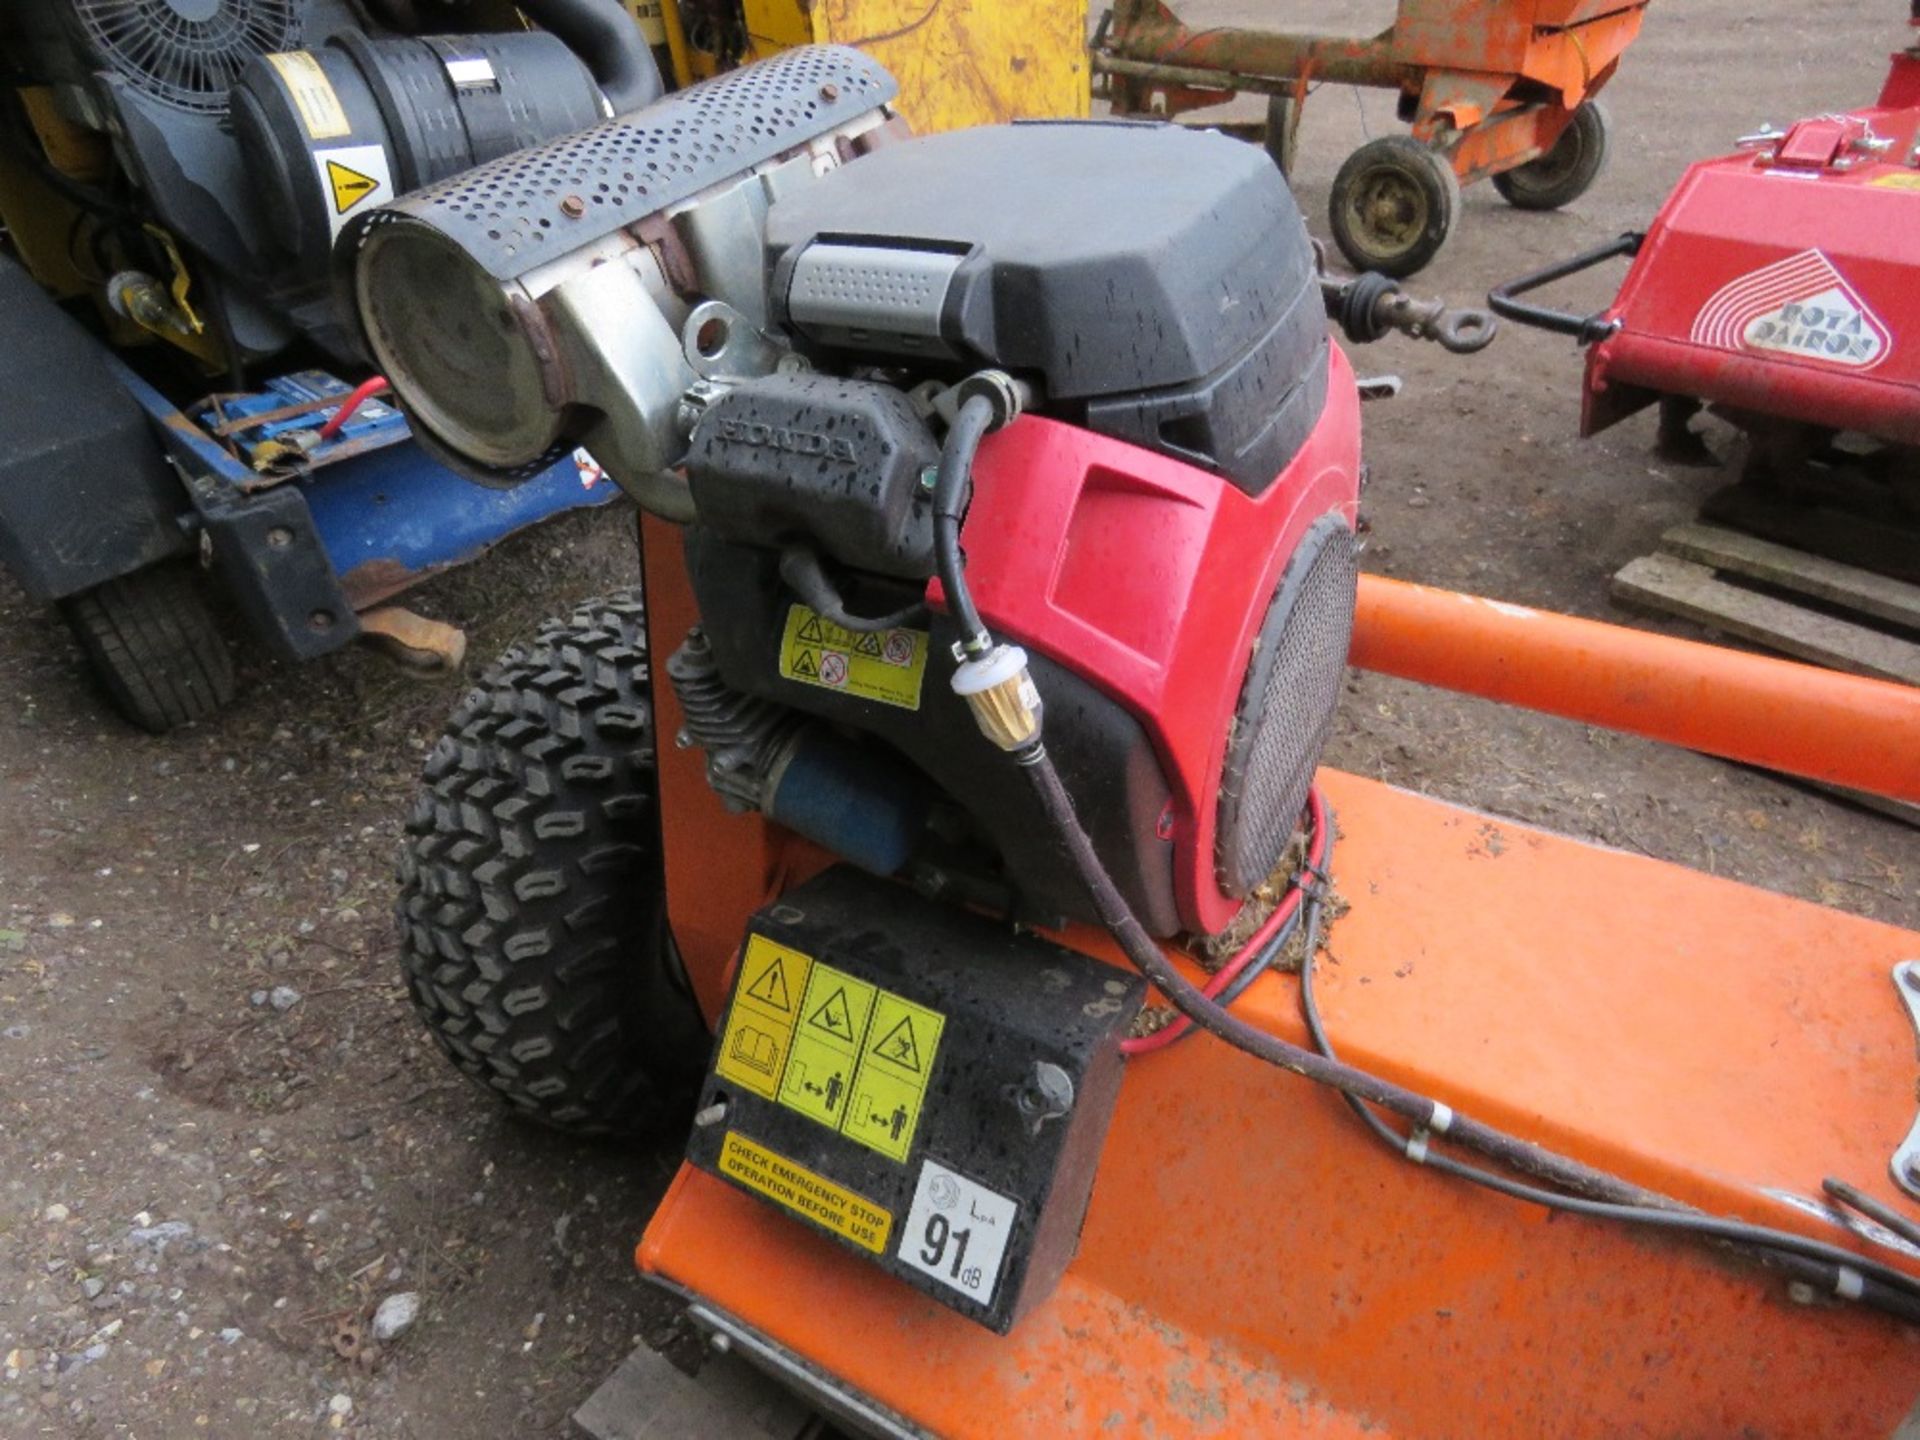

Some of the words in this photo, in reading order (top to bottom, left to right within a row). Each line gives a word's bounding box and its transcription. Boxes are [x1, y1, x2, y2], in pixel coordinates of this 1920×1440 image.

[1754, 322, 1873, 361] DAIRON
[1780, 301, 1862, 334] ROTA
[715, 418, 857, 464] HONDA
[728, 1158, 795, 1200] OPERATION
[797, 1194, 845, 1227] BEFORE
[850, 1222, 876, 1244] USE
[729, 1142, 768, 1168] CHECK
[771, 1163, 847, 1209] EMERGENCY
[850, 1204, 884, 1227] STOP
[919, 1213, 970, 1279] 91
[961, 1267, 982, 1289] dB
